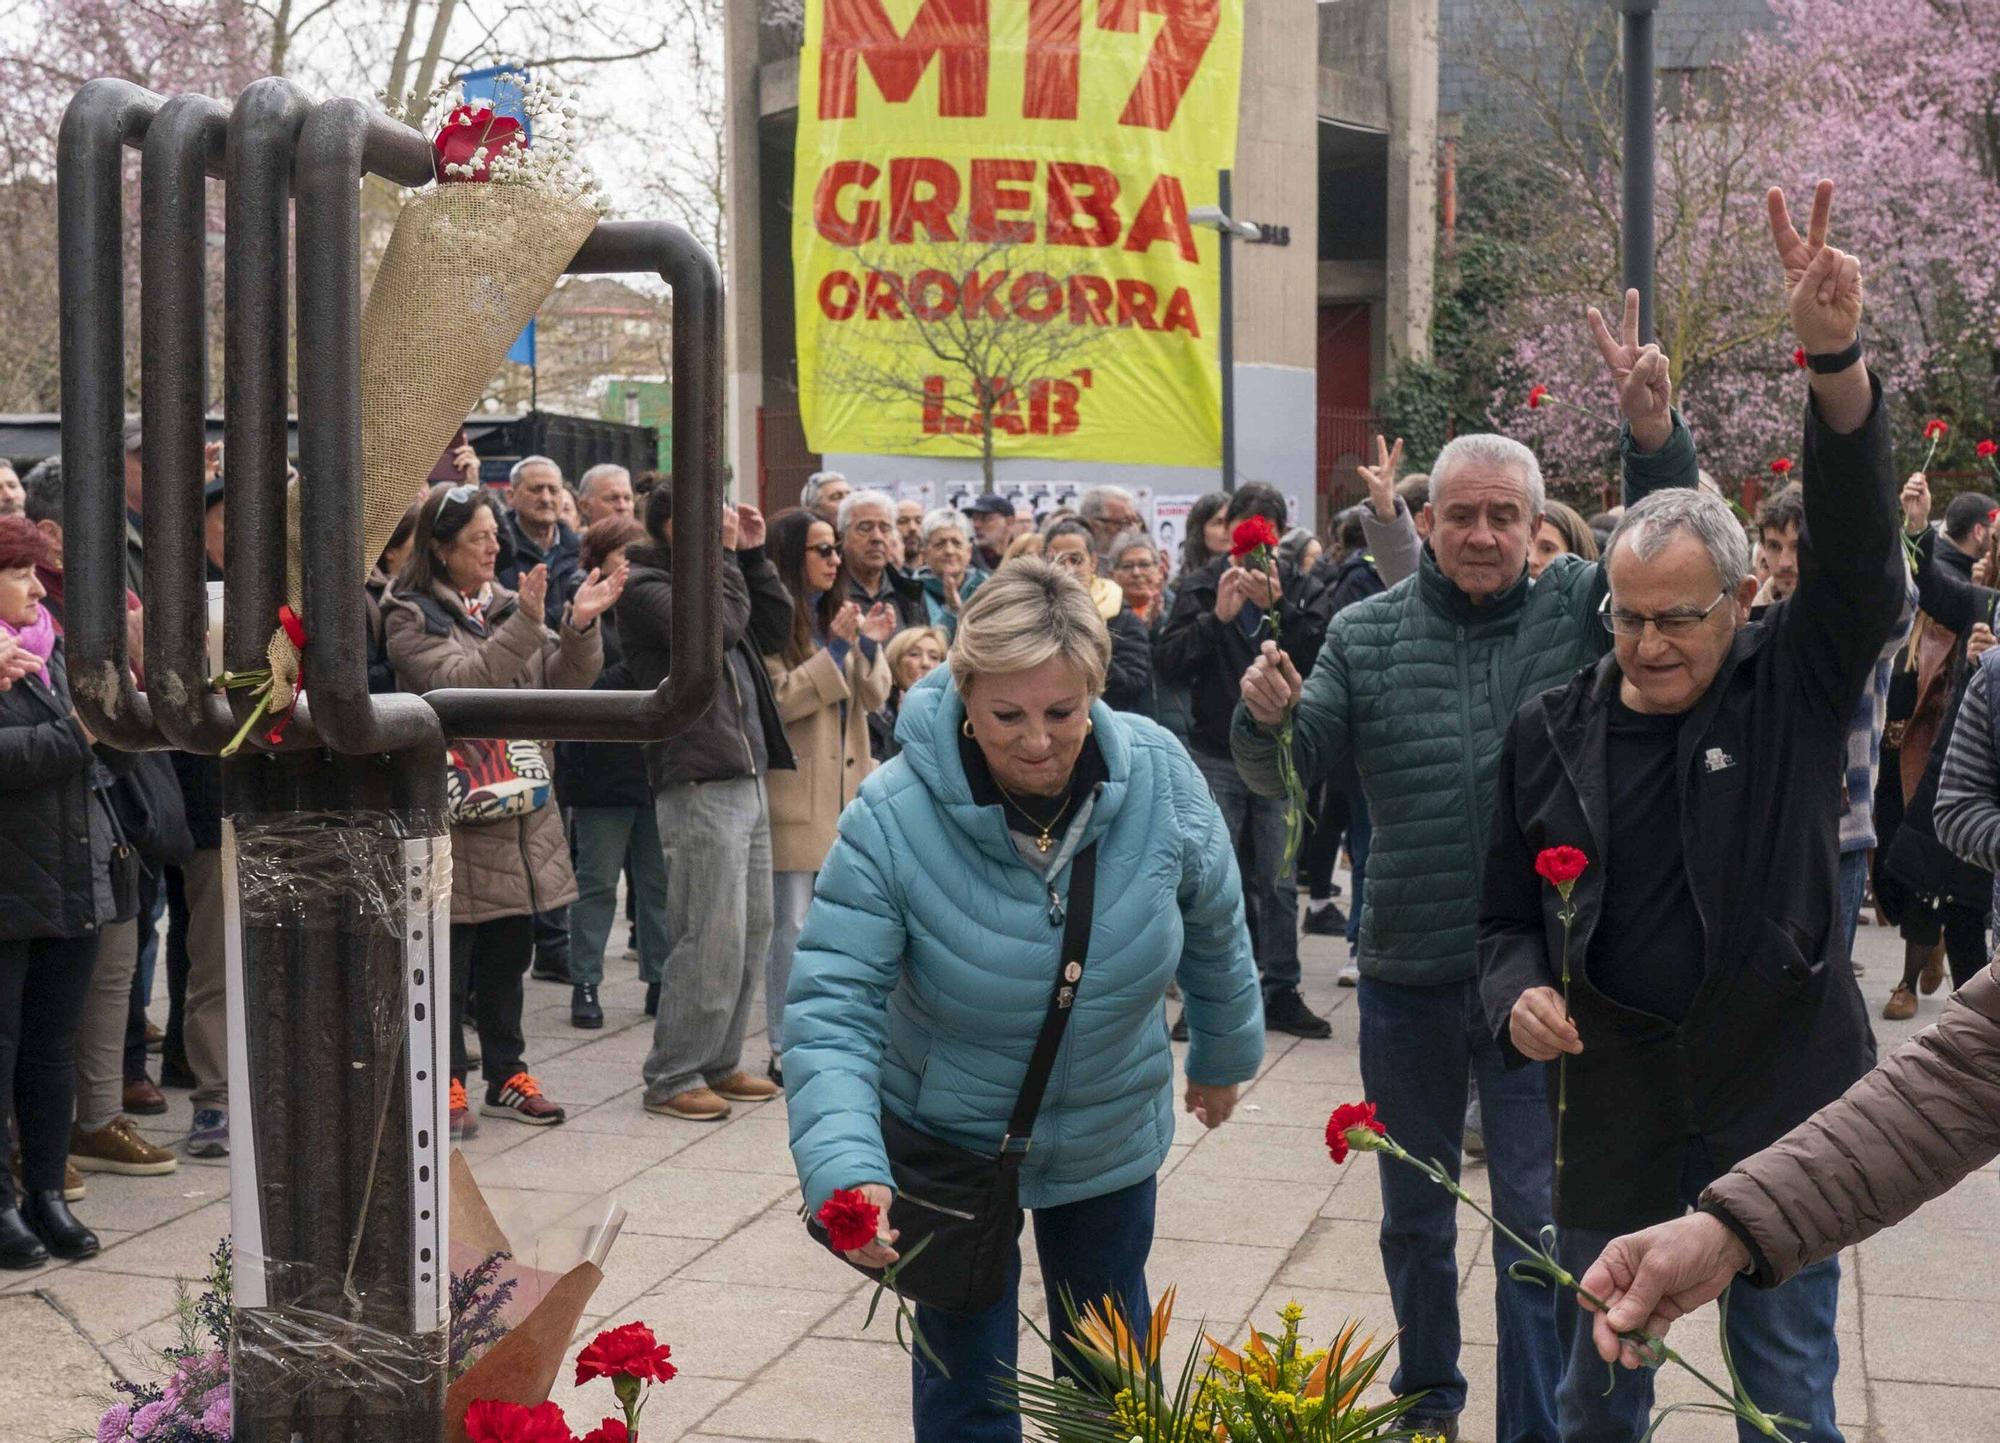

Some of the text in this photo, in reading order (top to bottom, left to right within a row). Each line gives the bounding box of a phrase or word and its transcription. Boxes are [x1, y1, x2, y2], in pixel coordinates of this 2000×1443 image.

[814, 157, 1200, 264] GREBA
[817, 269, 1201, 338] OROKORRA
[922, 374, 1081, 437] LAB
